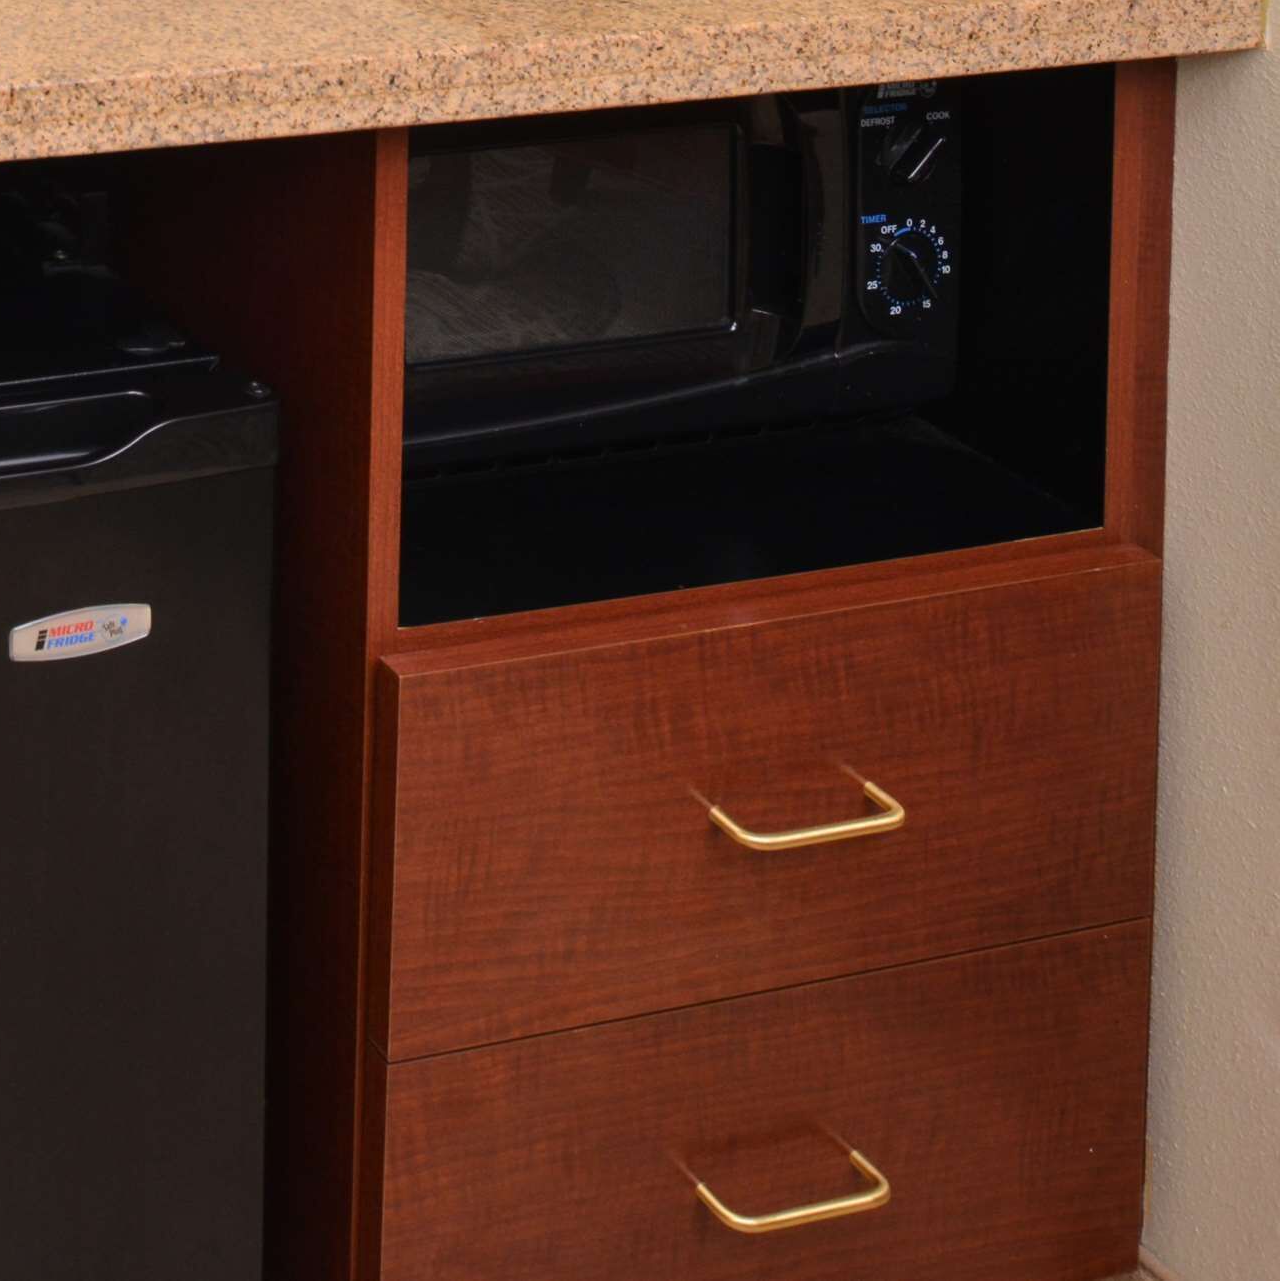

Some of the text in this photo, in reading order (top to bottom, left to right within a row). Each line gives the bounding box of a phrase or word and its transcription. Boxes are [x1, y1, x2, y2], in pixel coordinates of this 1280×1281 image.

[925, 110, 951, 121] COOK
[860, 115, 896, 128] DEFROST
[860, 213, 887, 224] TIMER
[906, 218, 913, 227] 0
[919, 219, 927, 228] 2
[881, 224, 898, 235] OFF
[929, 225, 937, 234] 4
[937, 236, 945, 246] 6
[870, 243, 882, 254] 30
[941, 250, 949, 260] 8
[941, 264, 951, 275] 10
[867, 280, 879, 291] 25
[922, 299, 932, 309] 15
[889, 305, 902, 316] 20
[48, 620, 96, 638] MICRO
[47, 631, 97, 650] FRIDGE
